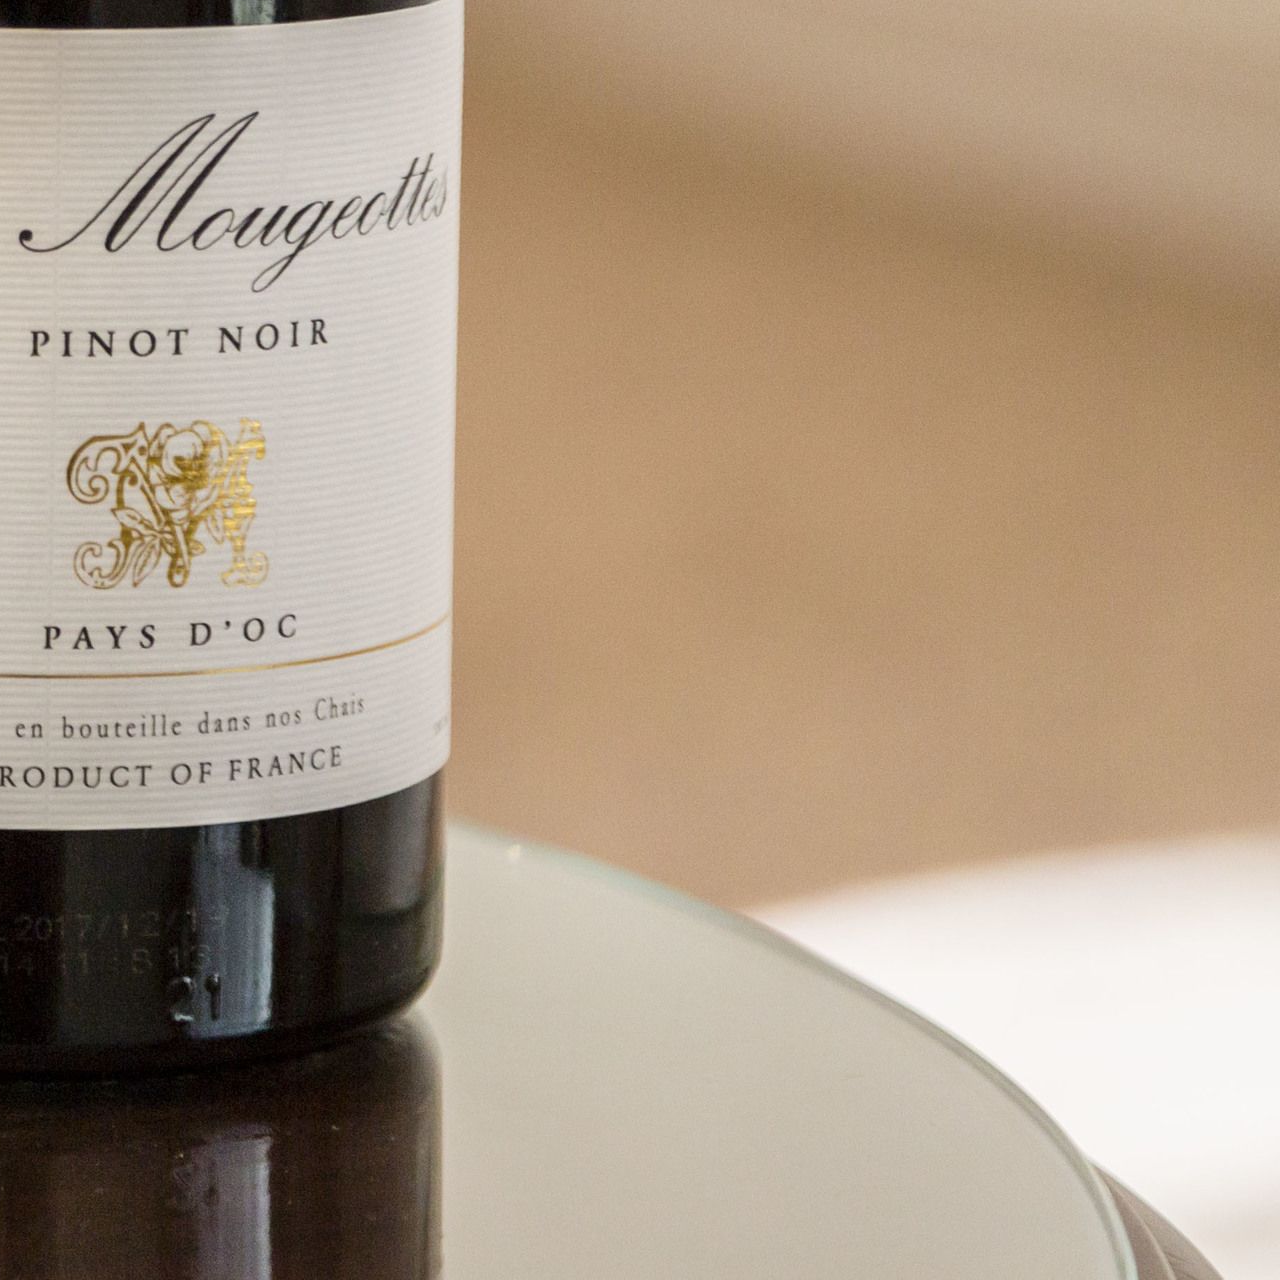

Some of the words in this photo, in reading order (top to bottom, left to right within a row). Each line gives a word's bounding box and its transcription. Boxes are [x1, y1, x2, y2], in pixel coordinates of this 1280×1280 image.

[18, 110, 448, 293] Mougeottes
[29, 327, 190, 358] PINOT
[218, 318, 329, 354] NOIR
[43, 623, 157, 651] PAYS
[189, 613, 298, 648] D'OC
[15, 722, 44, 739] en
[61, 714, 183, 739] bouteille
[197, 710, 251, 735] dans
[265, 709, 302, 729] nos
[313, 693, 366, 722] Chais
[170, 761, 213, 786] OF
[228, 745, 342, 782] FRANCE
